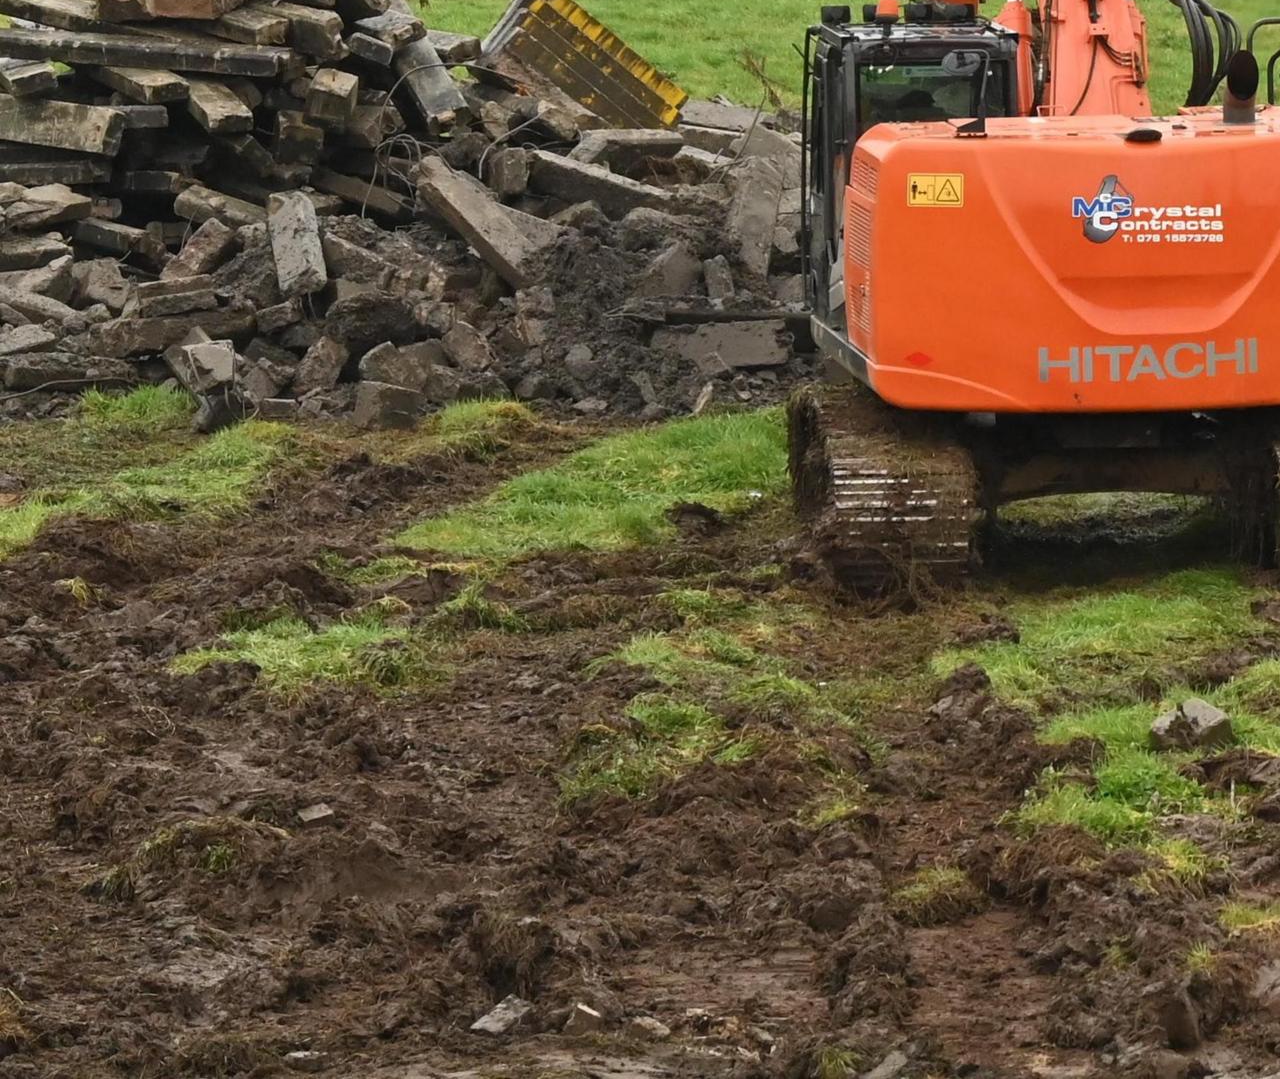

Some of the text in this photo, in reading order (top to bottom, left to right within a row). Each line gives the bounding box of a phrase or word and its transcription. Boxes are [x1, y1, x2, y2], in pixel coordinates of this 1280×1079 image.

[1092, 211, 1224, 231] Contracts
[1136, 234, 1160, 243] 078
[1037, 337, 1258, 383] HITACHI
